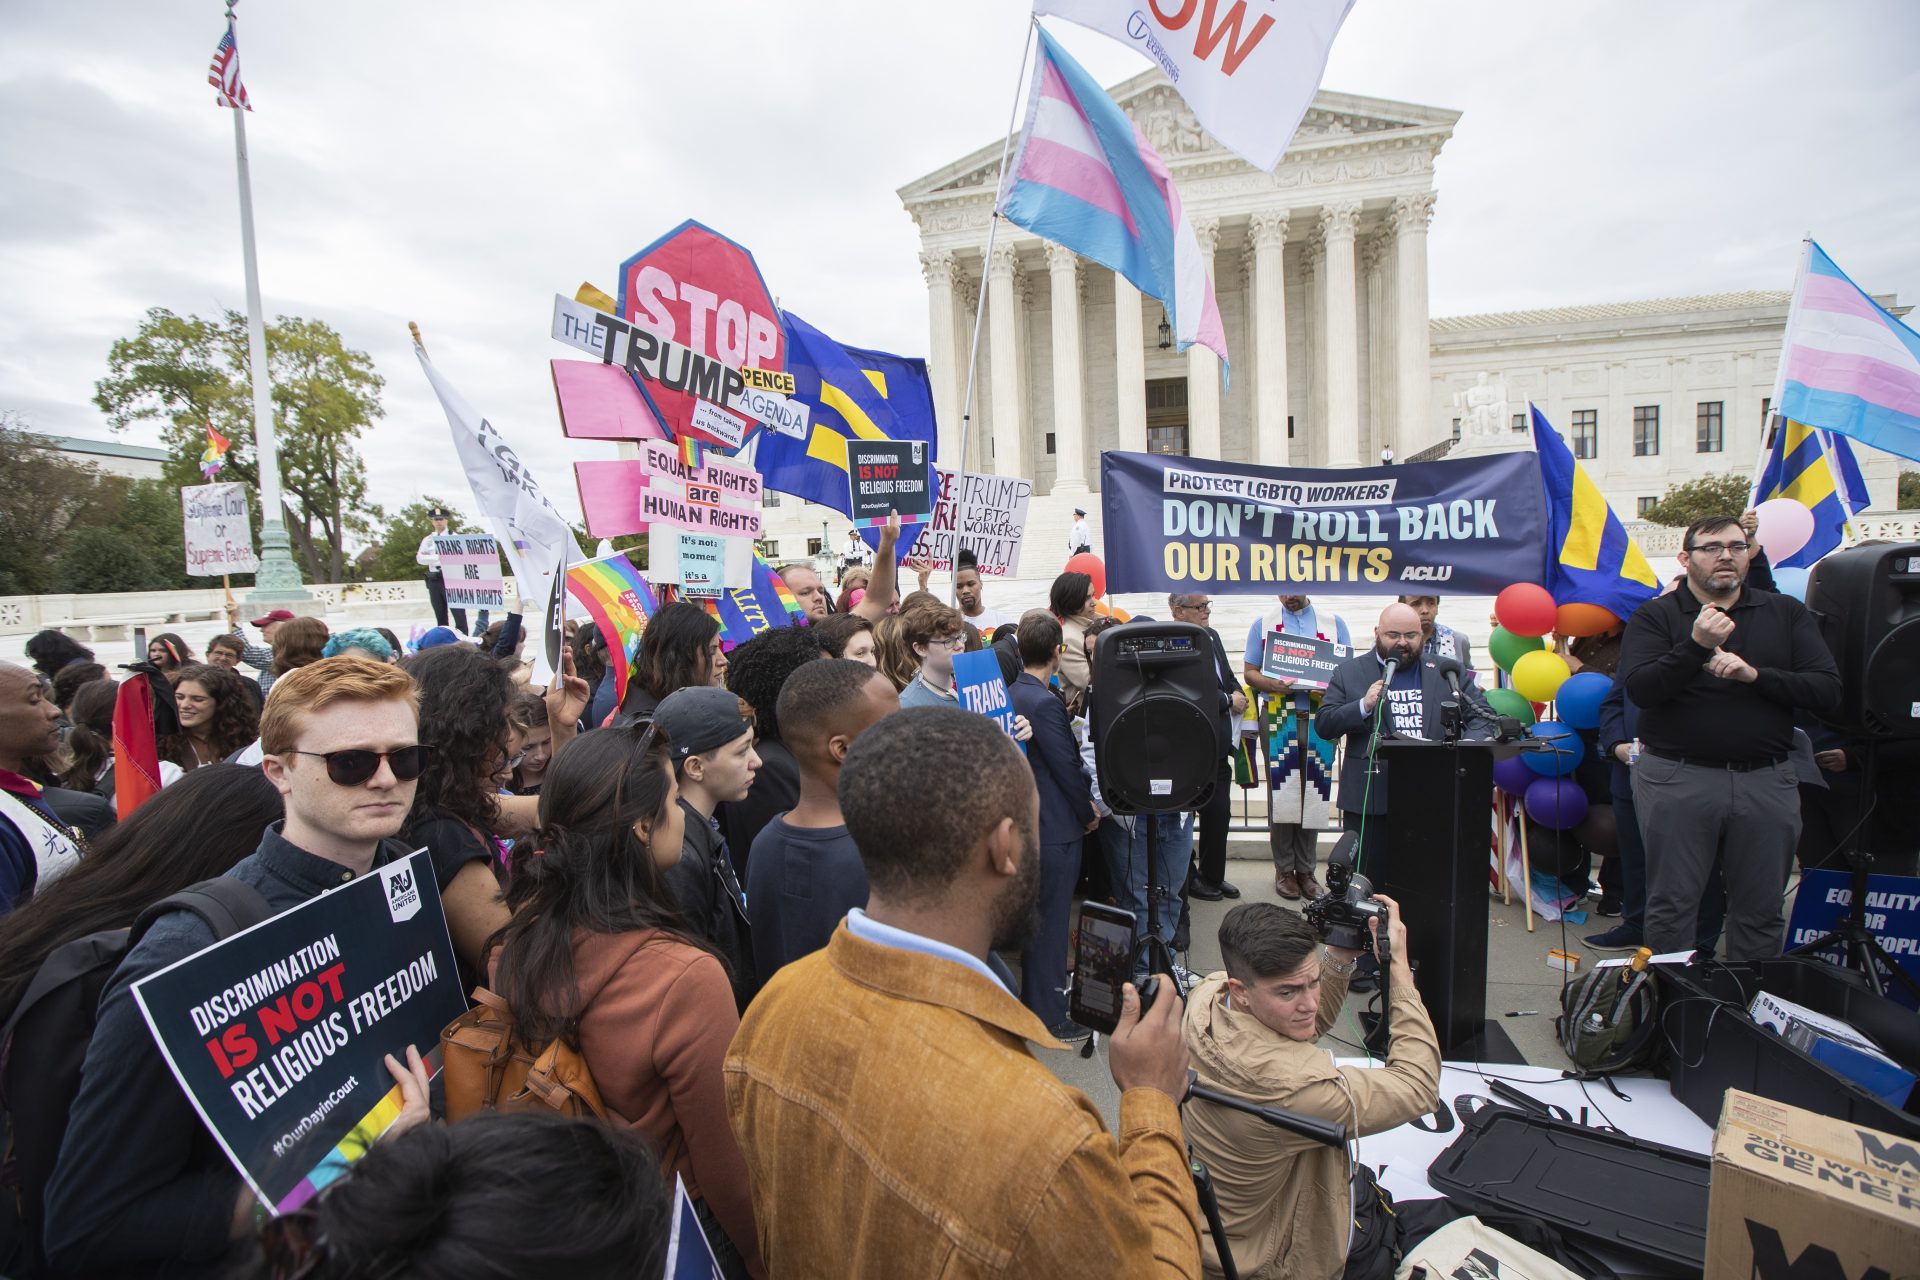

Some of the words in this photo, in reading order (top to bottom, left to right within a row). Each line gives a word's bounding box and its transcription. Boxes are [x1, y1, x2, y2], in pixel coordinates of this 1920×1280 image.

[635, 266, 777, 371] STOP
[563, 313, 605, 349] THE
[596, 312, 745, 408] TRUMP
[743, 368, 794, 391] PENCE
[723, 416, 742, 432] taking
[740, 390, 803, 433] AGENDA
[696, 419, 706, 427] us
[707, 422, 740, 445] backwards.
[857, 454, 899, 465] DISCRIMINATION
[858, 465, 872, 480] IS
[873, 464, 899, 479] NOT
[707, 466, 758, 495] RIGHTS
[860, 480, 894, 495] RELIGIOUS
[895, 479, 924, 493] FREEDOM
[963, 475, 1031, 509] TRUMP
[1169, 471, 1244, 495] PROTECT
[1247, 480, 1303, 505] LGBTQ
[1306, 483, 1390, 503] WORKERS
[689, 486, 720, 504] are
[644, 495, 703, 524] HUMAN
[709, 508, 759, 533] RIGHTS
[967, 506, 1011, 526] LGBTQ
[1163, 498, 1282, 538] DON'T
[1291, 508, 1389, 543] ROLL
[1395, 499, 1500, 541] BACK
[214, 524, 227, 538] or
[963, 521, 1023, 539] WORKERS
[435, 540, 464, 556] TRANS
[465, 538, 496, 555] RIGHTS
[990, 540, 1018, 567] ACT
[463, 563, 480, 580] ARE
[1164, 541, 1241, 582] OUR
[1250, 543, 1393, 583] RIGHTS
[1400, 565, 1453, 582] ACLU
[445, 587, 475, 605] HUMAN
[476, 588, 503, 606] RIGHTS
[1272, 645, 1286, 655] IS
[1287, 647, 1316, 659] NOT
[1273, 638, 1316, 652] DISCRIMINATION
[1272, 653, 1310, 667] RELIGIOUS
[962, 678, 1007, 714] TRANS
[42, 825, 68, 858] 光
[391, 889, 416, 905] AMERICANS
[392, 894, 417, 912] UNITED
[1825, 887, 1920, 912] EQALITY
[190, 933, 341, 1037] DISCRIMINATION
[205, 1022, 258, 1080] IS
[256, 962, 346, 1046] NOT
[230, 1011, 349, 1121] RELIGIOUS
[347, 950, 439, 1035] FREEDOM
[272, 1075, 360, 1158] #OurDayinCourt
[1746, 1132, 1816, 1162] 2000
[1824, 1158, 1916, 1194] WATT
